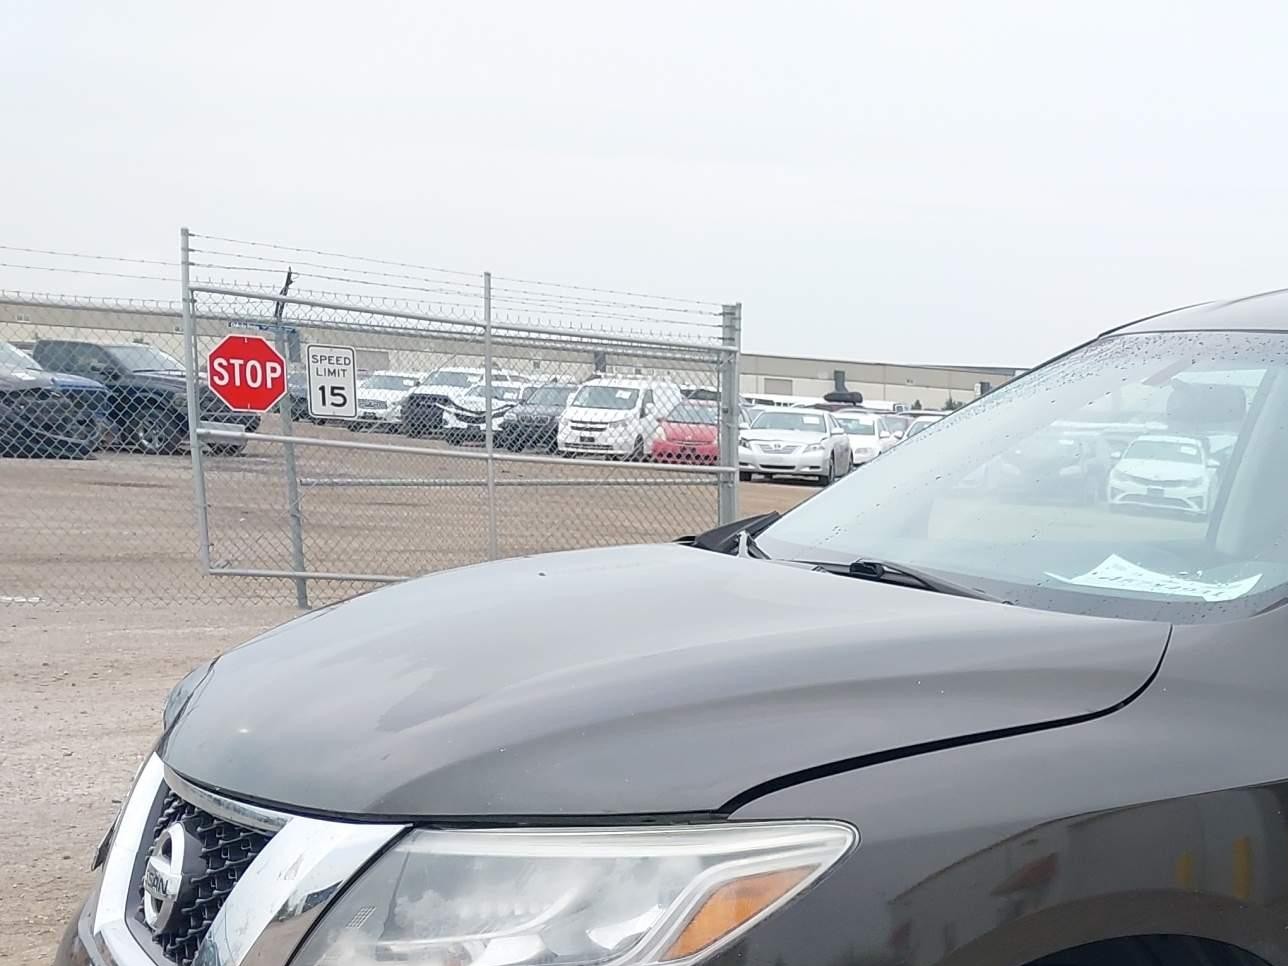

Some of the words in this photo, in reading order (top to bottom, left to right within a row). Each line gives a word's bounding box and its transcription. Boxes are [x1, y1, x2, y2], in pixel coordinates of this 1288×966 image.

[311, 354, 351, 366] SPEED
[213, 357, 282, 389] STOP
[315, 367, 348, 378] LIMIT
[318, 385, 348, 408] 15
